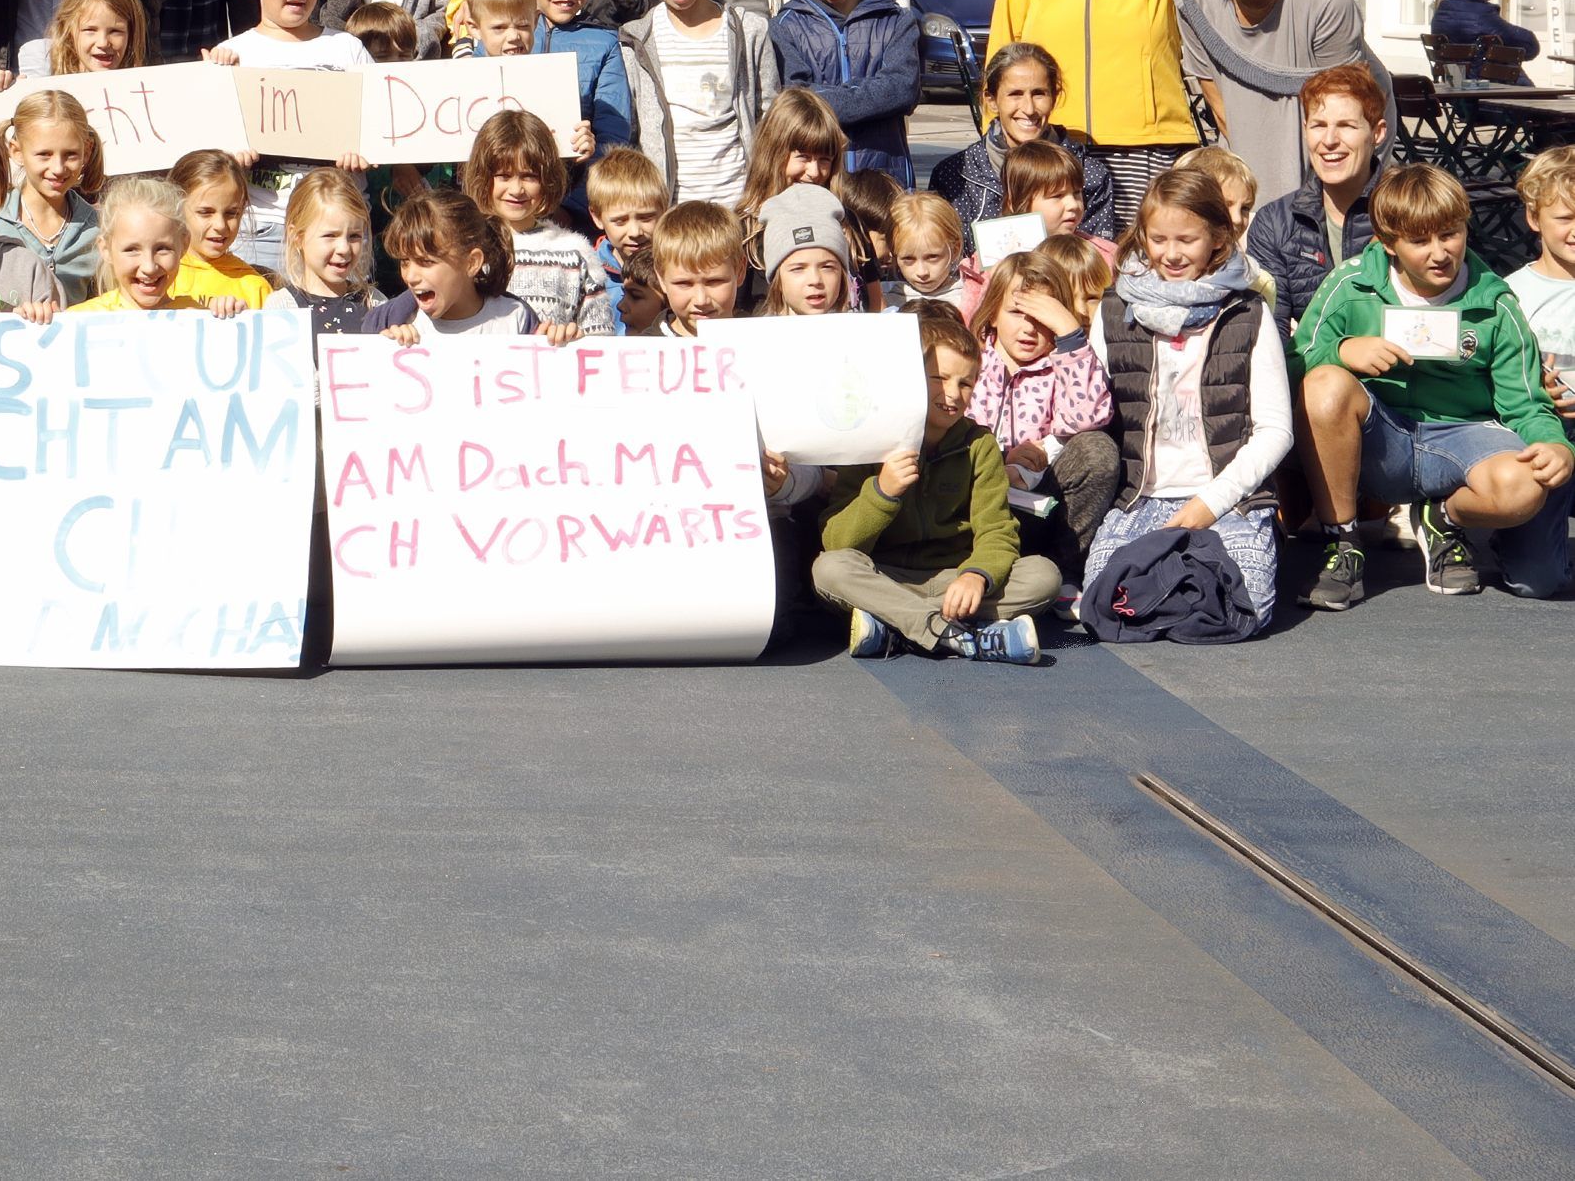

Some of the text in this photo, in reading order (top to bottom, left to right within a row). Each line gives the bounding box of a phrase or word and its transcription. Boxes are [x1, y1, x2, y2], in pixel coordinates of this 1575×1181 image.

[259, 77, 303, 135] im
[327, 346, 433, 423] ES
[576, 345, 745, 396] FEUER
[159, 392, 301, 483] AM
[333, 443, 434, 508] AM
[614, 441, 757, 490] MA-
[332, 501, 763, 579] CH VORWÄRTS
